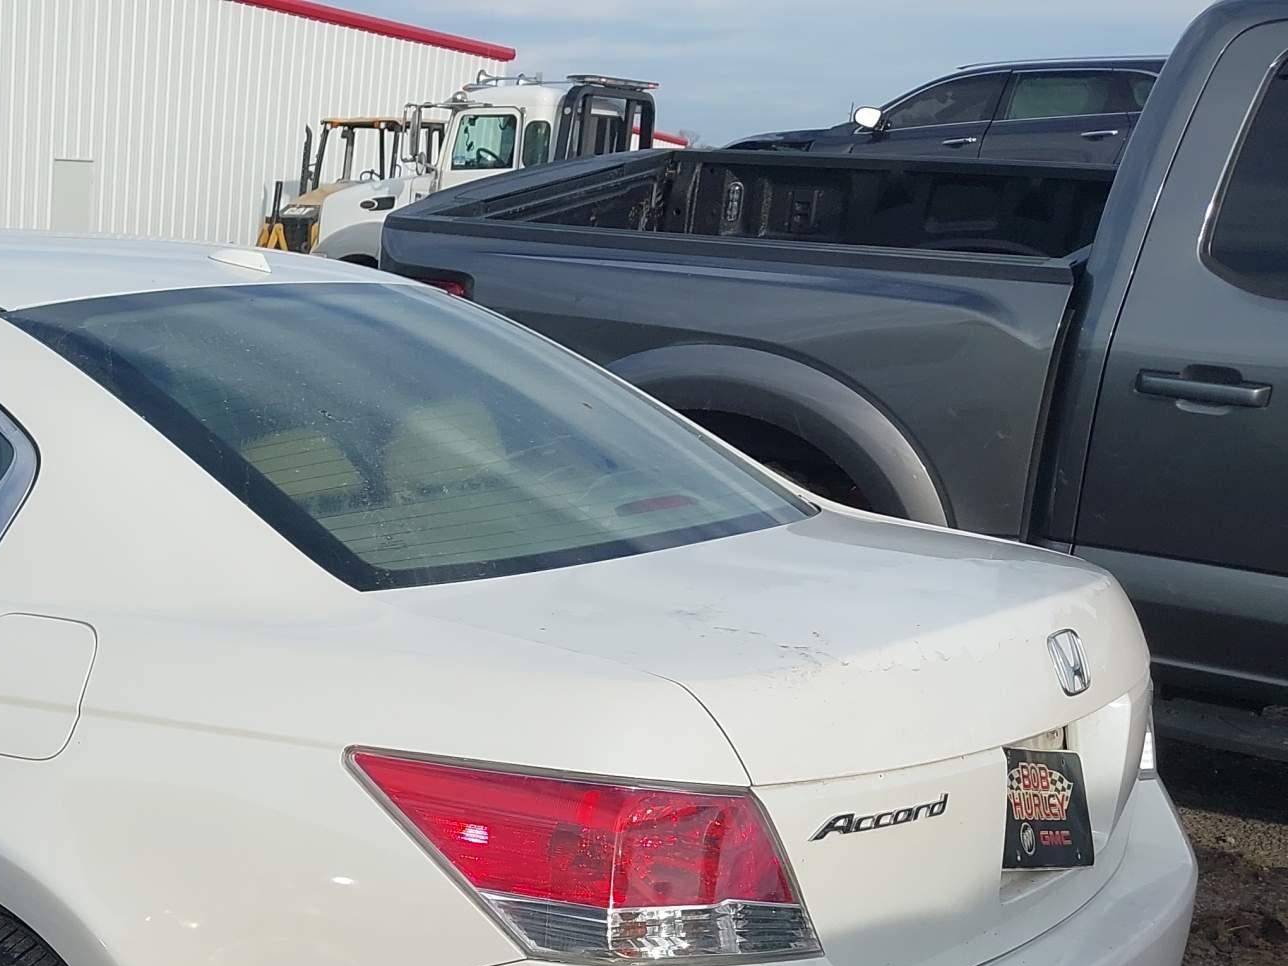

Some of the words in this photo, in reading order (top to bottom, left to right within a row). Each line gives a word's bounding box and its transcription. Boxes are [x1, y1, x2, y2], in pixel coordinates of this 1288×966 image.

[1019, 763, 1050, 790] BOB
[808, 793, 949, 841] Accord
[1012, 791, 1067, 820] HURLEY
[1039, 830, 1072, 846] GMC
